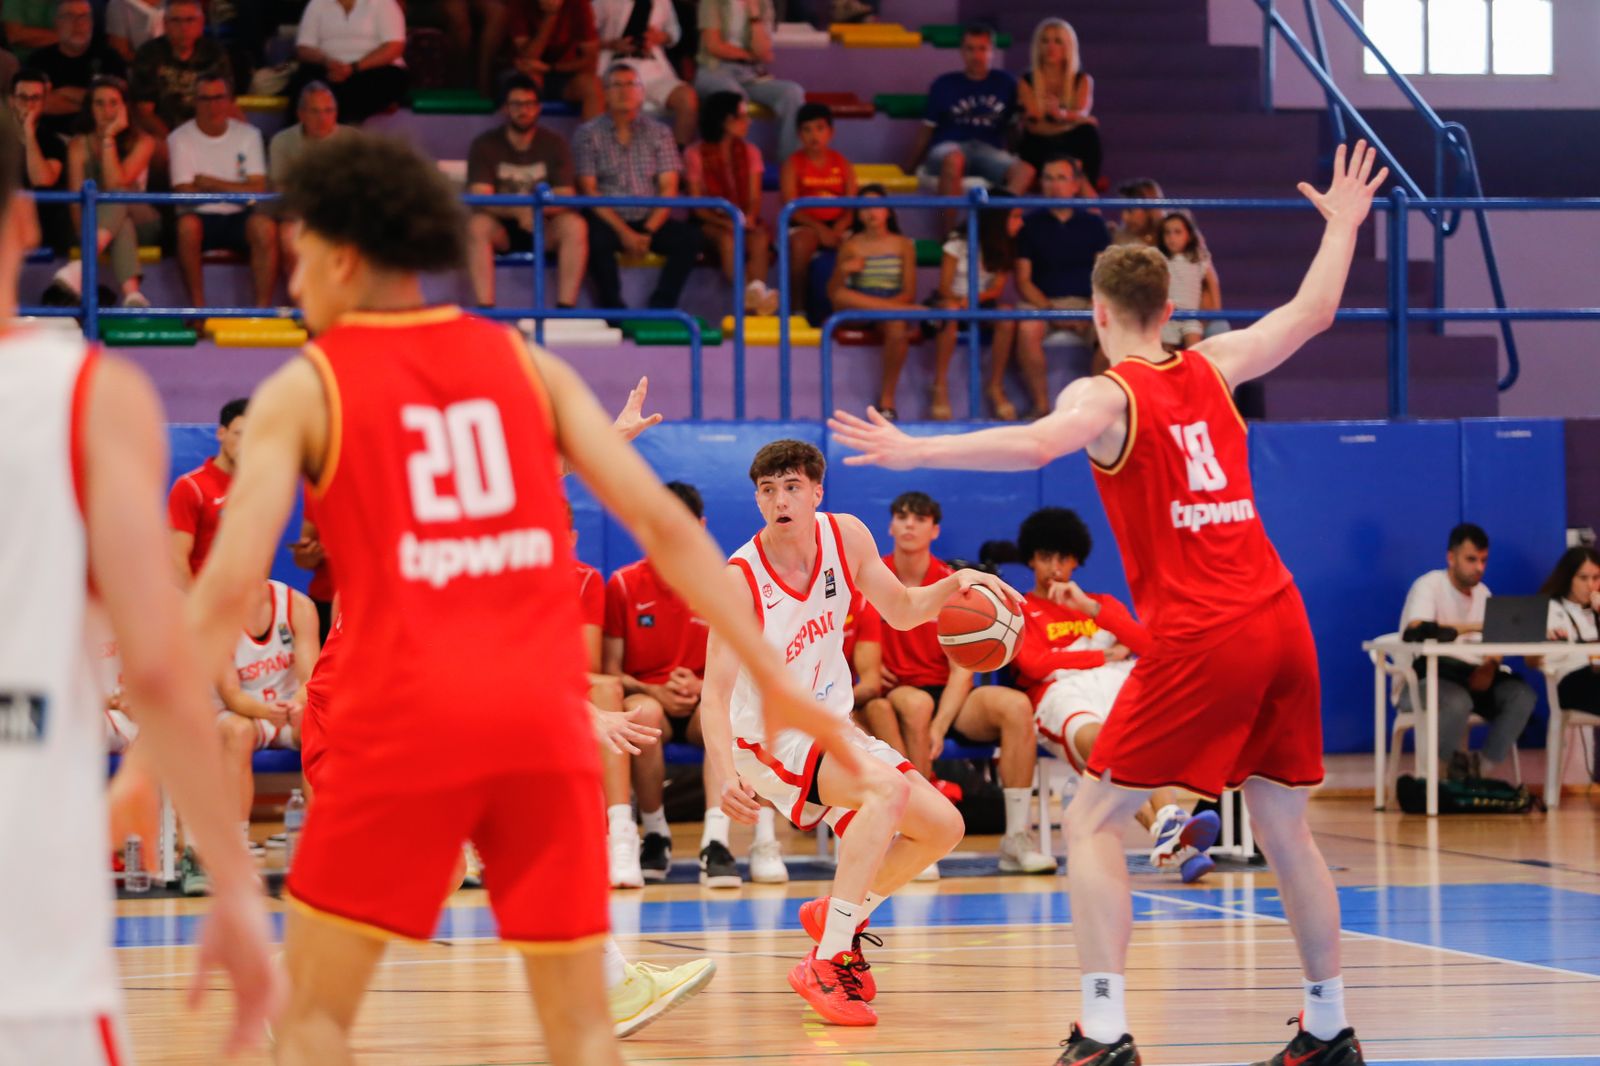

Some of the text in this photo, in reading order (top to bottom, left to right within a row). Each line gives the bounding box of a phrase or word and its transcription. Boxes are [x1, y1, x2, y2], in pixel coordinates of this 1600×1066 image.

[402, 398, 516, 523] 20
[1169, 421, 1228, 491] 18
[1170, 498, 1254, 532] tipwin
[399, 527, 553, 588] tipwin
[1047, 618, 1098, 640] ESPAÑ
